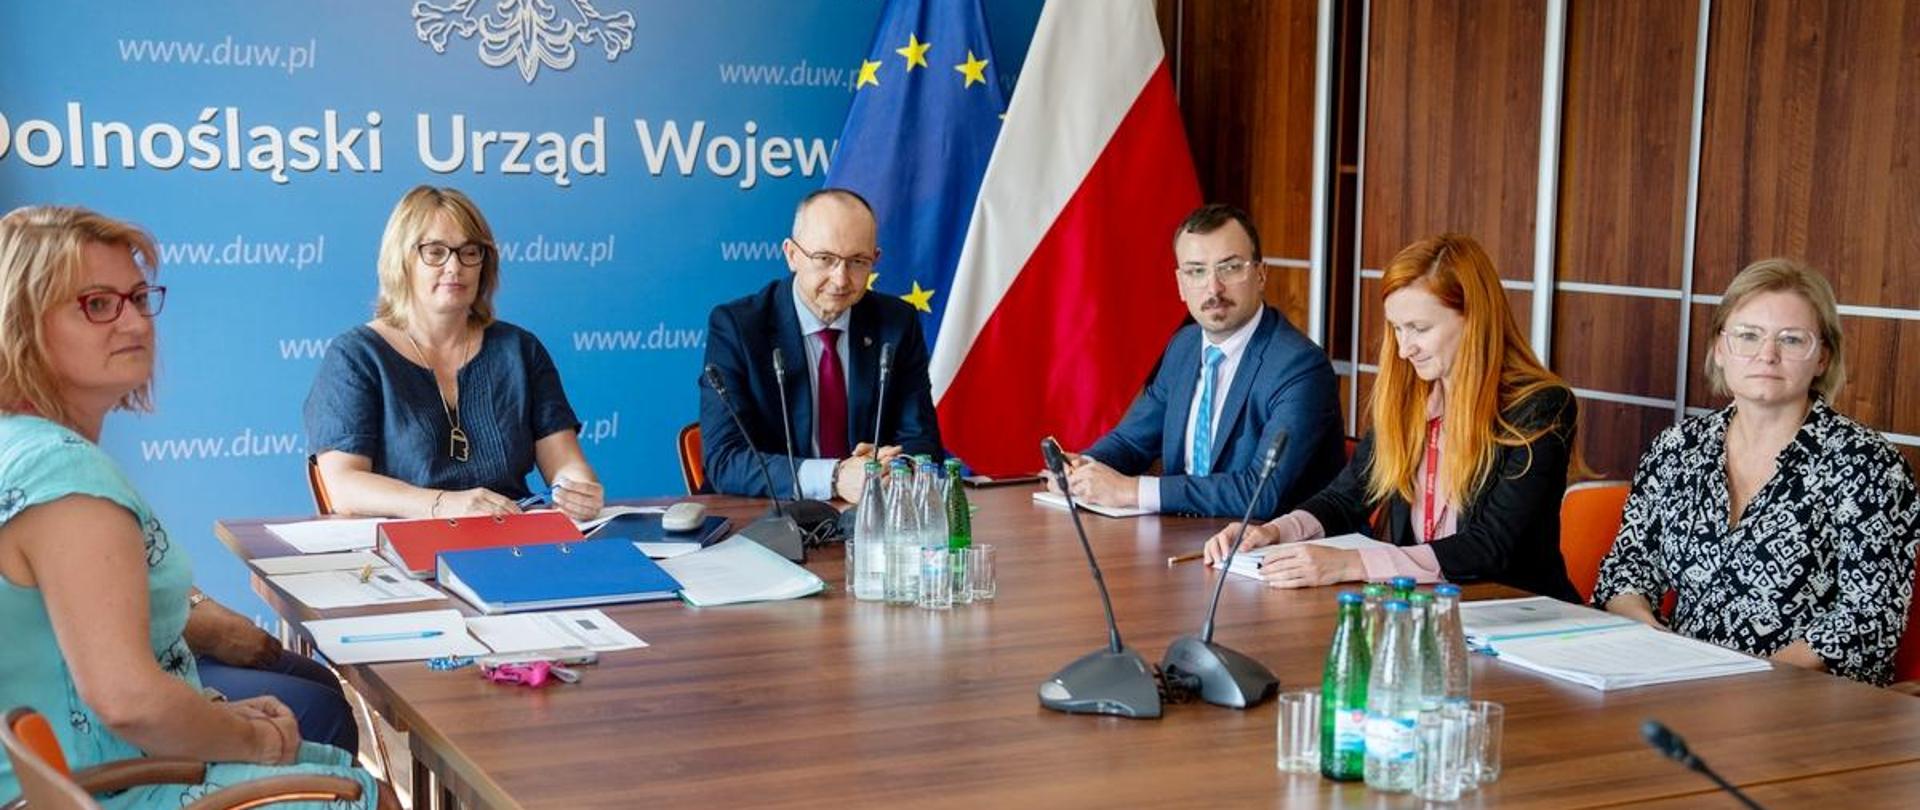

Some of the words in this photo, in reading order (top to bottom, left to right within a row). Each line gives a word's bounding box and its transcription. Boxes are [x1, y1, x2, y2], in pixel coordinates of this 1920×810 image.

[118, 35, 316, 74] www.duw.pl
[0, 102, 384, 184] olnośląski
[417, 113, 607, 186] Urząd
[159, 234, 325, 270] ww.duw.pl
